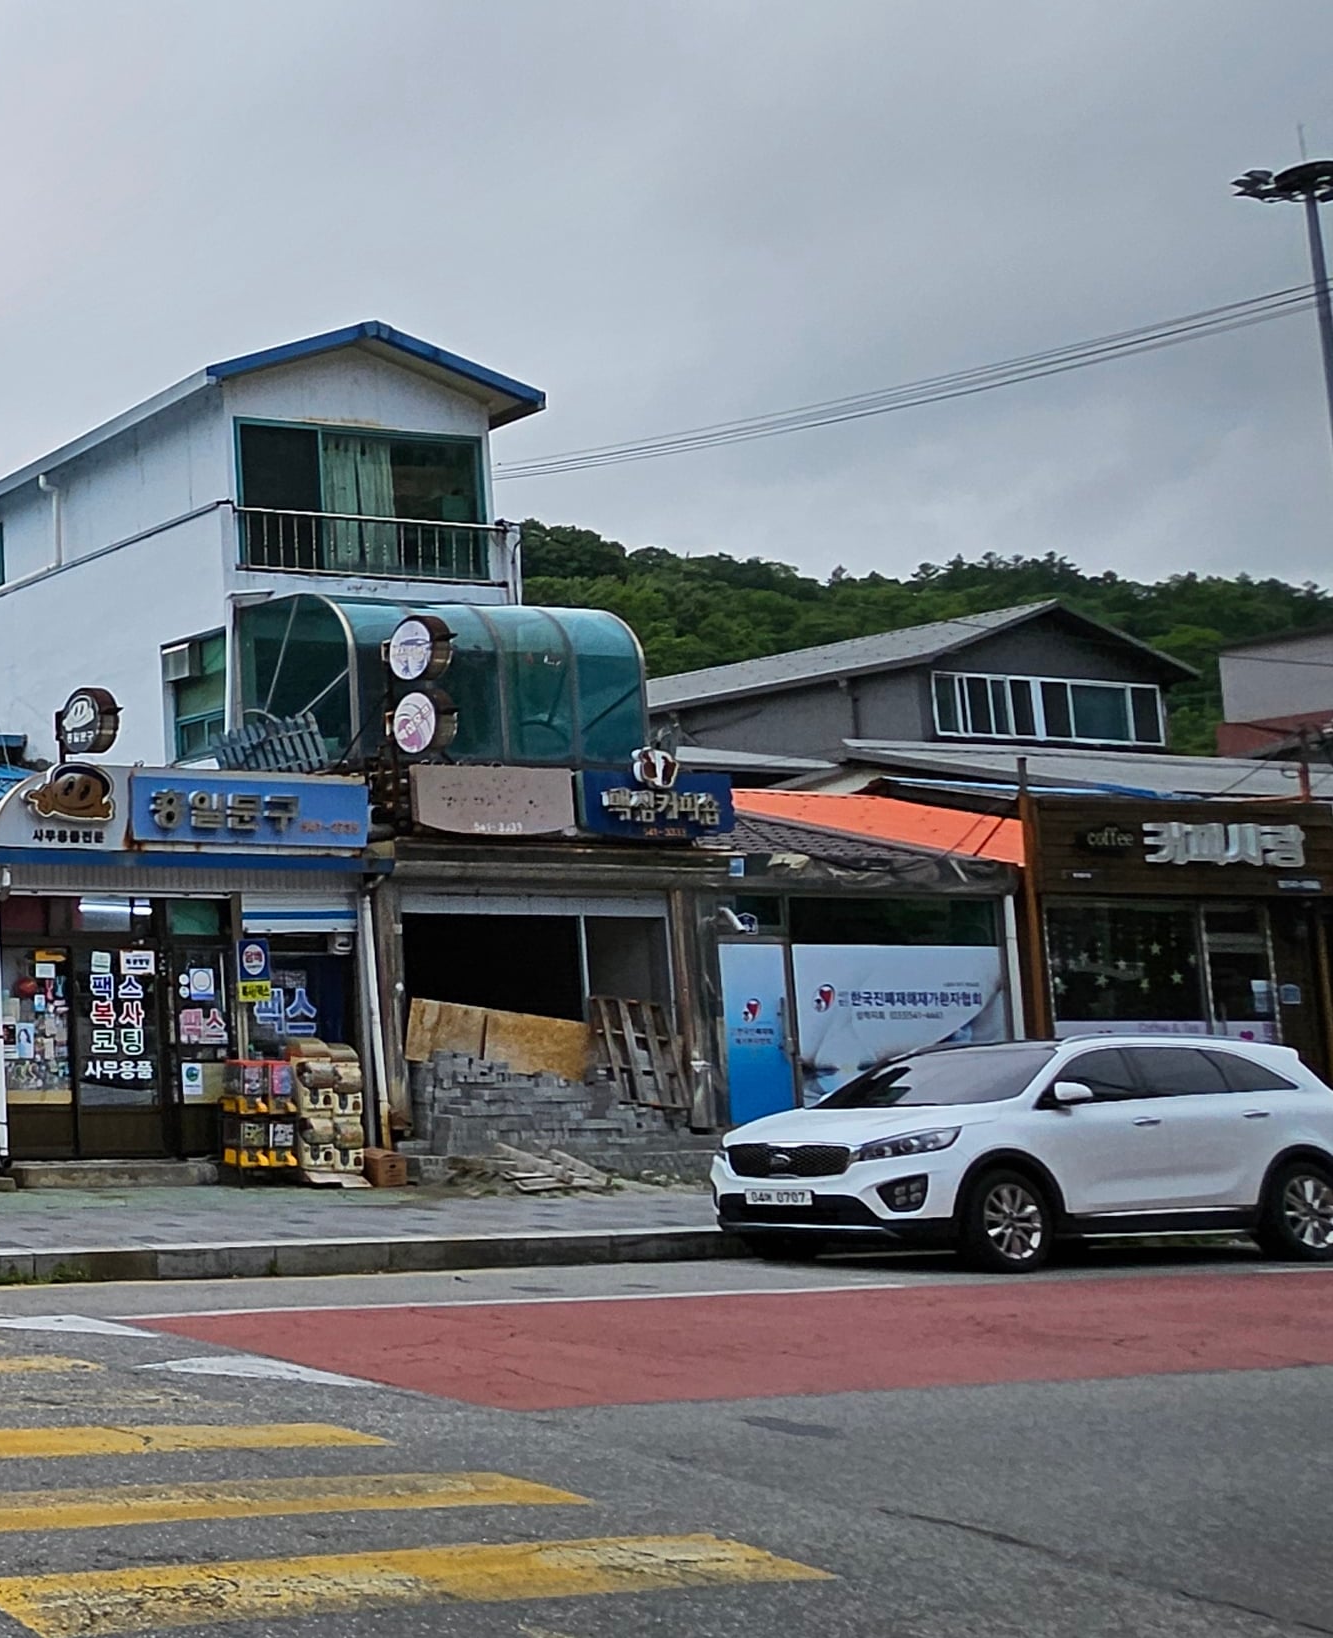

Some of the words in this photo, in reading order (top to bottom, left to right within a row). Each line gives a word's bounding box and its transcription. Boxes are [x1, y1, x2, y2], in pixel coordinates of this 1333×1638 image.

[1087, 826, 1133, 846] coffee
[1142, 822, 1306, 867] 커피사랑
[90, 974, 144, 1000] 팩스
[90, 1000, 145, 1027] 복사
[253, 988, 317, 1036] 팩스
[179, 1008, 229, 1044] 팩스
[91, 1029, 145, 1055] 코팅
[85, 1061, 153, 1079] 사무용품
[776, 1191, 806, 1204] 0707
